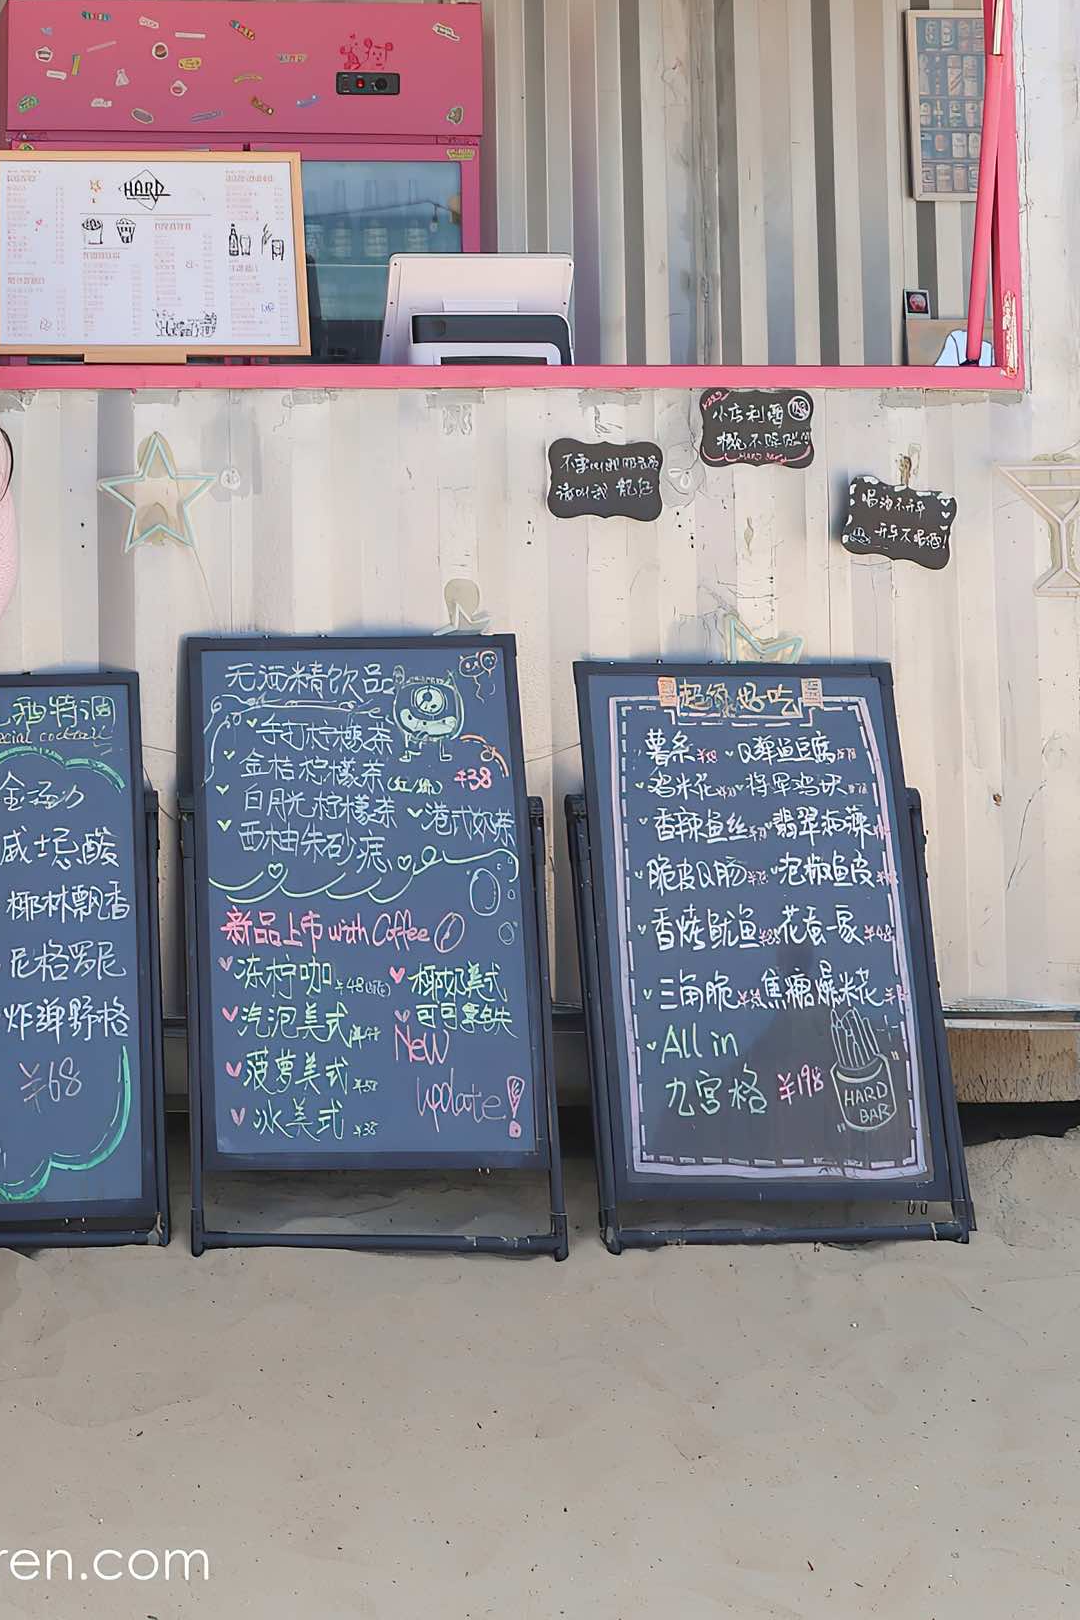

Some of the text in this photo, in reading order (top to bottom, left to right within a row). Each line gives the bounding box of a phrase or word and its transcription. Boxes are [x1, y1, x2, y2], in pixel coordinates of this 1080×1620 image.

[645, 728, 695, 767] 薯条
[244, 782, 399, 828] 白月光柠檬茶
[647, 771, 717, 800] 鸡米花
[421, 801, 516, 848] 港式奶茶
[0, 825, 121, 870] 威士忌酸
[6, 880, 131, 924] 椰林飘香
[221, 905, 323, 953] 新品上市
[328, 913, 370, 946] with
[10, 939, 127, 982] 尼格罗尼
[661, 1022, 739, 1064] All in
[244, 1047, 349, 1095] 菠萝美式
[666, 1063, 769, 1117] 九宫格
[844, 1081, 889, 1106] HARD
[859, 1102, 892, 1123] BAR
[253, 1098, 345, 1141] 冰美式
